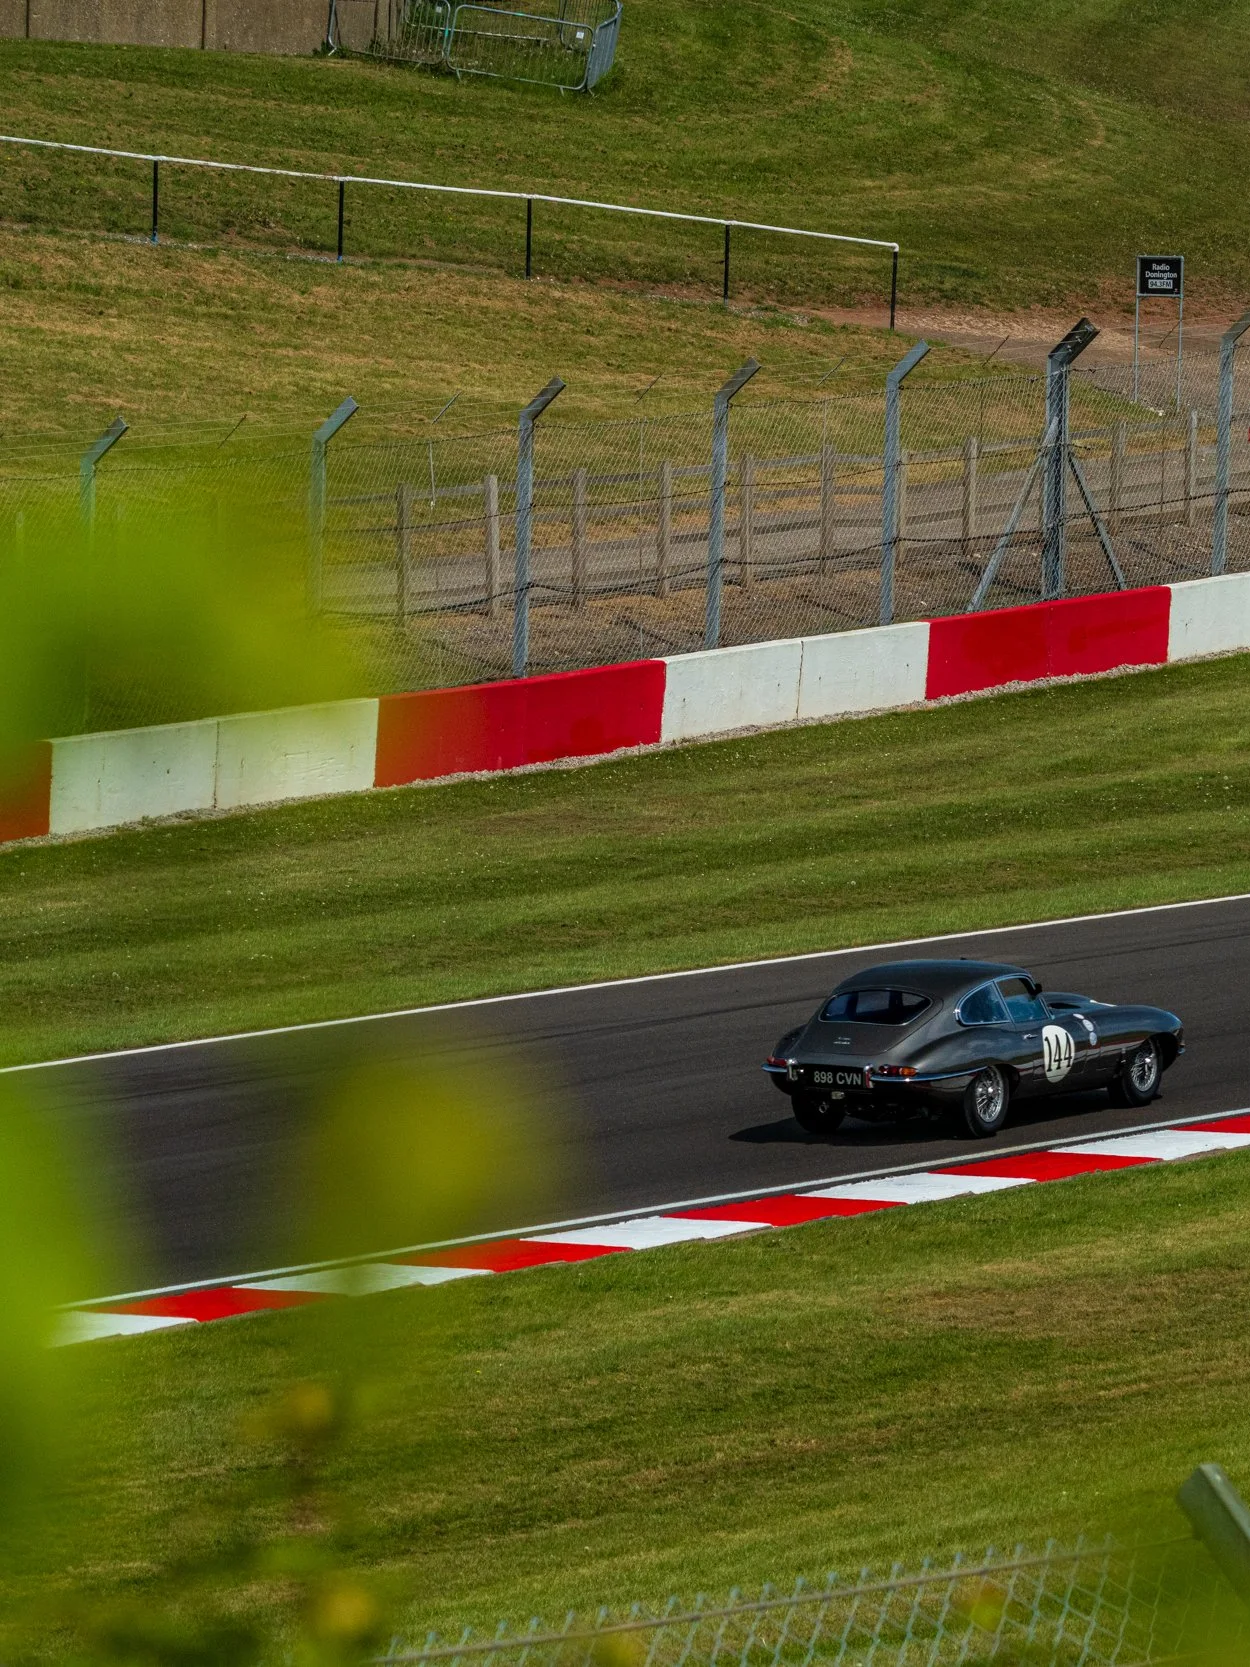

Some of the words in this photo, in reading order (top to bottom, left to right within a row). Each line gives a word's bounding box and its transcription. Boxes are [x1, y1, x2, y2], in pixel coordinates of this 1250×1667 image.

[1145, 271, 1178, 279] Donington
[1044, 1032, 1073, 1072] 144
[814, 1071, 833, 1084] 898
[836, 1072, 862, 1085] CVN
